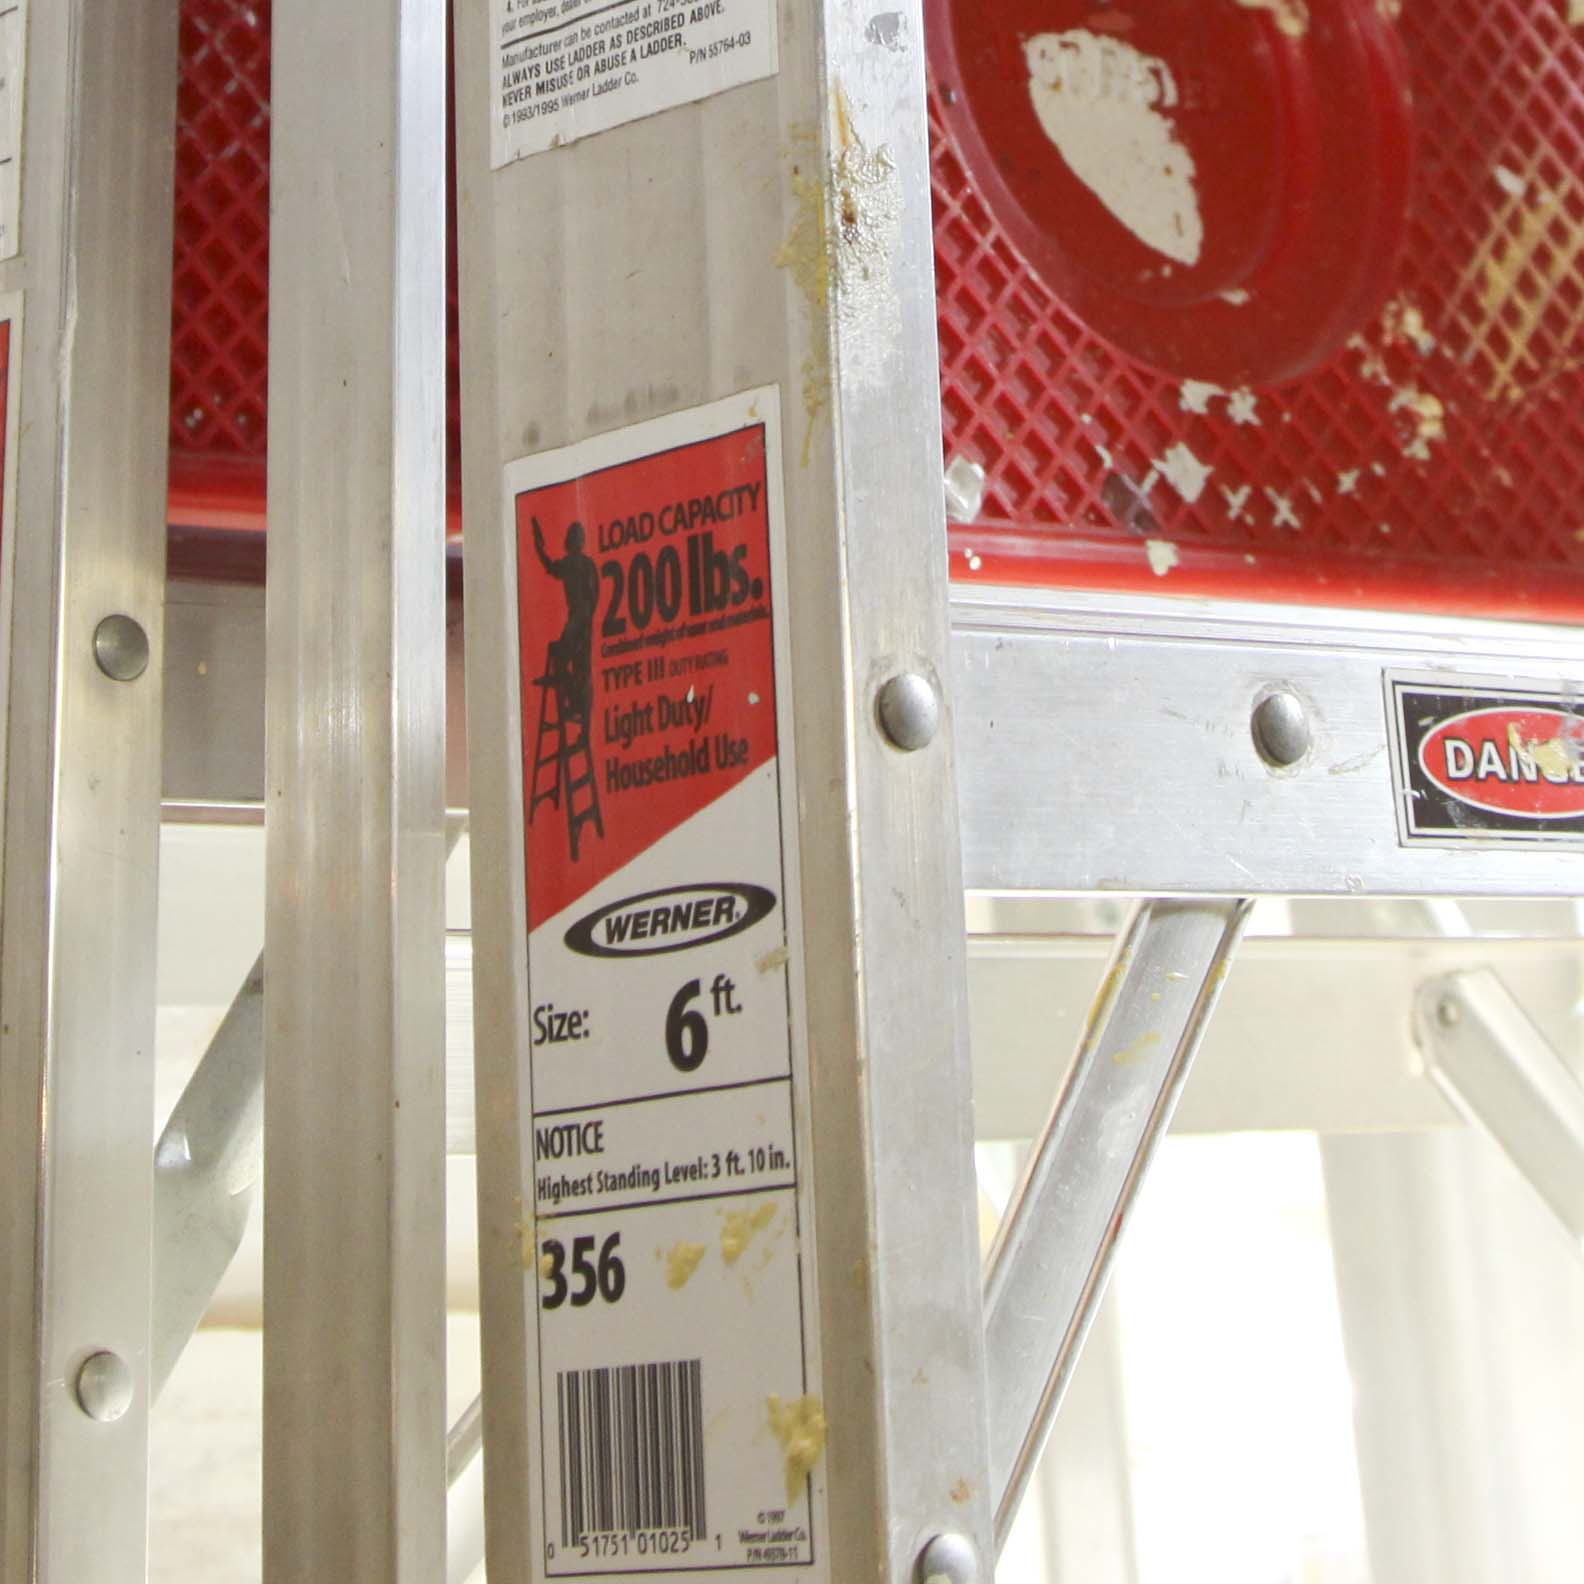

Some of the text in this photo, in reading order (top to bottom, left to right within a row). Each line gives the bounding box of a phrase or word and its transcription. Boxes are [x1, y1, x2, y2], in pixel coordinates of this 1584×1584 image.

[502, 35, 561, 69] Manufacturer
[563, 28, 577, 48] can
[580, 23, 591, 41] be
[594, 6, 639, 36] contacted
[642, 2, 651, 19] at
[502, 62, 540, 89] ALWAYS
[545, 54, 564, 75] USE
[567, 39, 604, 68] LADDER
[609, 33, 622, 52] AS
[626, 12, 684, 46] DESCRIBED
[503, 30, 686, 108] NEVER MISUSE OR ABUSE A LADDER.
[561, 85, 589, 110] Werner
[592, 74, 621, 98] Ladder
[624, 68, 639, 87] Co.
[689, 46, 706, 66] P/N
[598, 481, 762, 553] LOAD CAPACITY
[601, 532, 764, 638] 200 lbs.
[602, 661, 643, 693] TYPE
[648, 656, 664, 682] III
[604, 685, 715, 751] Light Duty/
[605, 734, 750, 794] Household Use
[605, 895, 736, 945] WERNER
[533, 973, 742, 1073] Size: 6 ft.
[536, 1120, 605, 1161] NOTICE
[537, 1144, 790, 1205] Highest Standing Level: 3 ft. 10 in.
[541, 1231, 626, 1310] 356
[546, 1530, 722, 1560] 0 51751 01025 1
